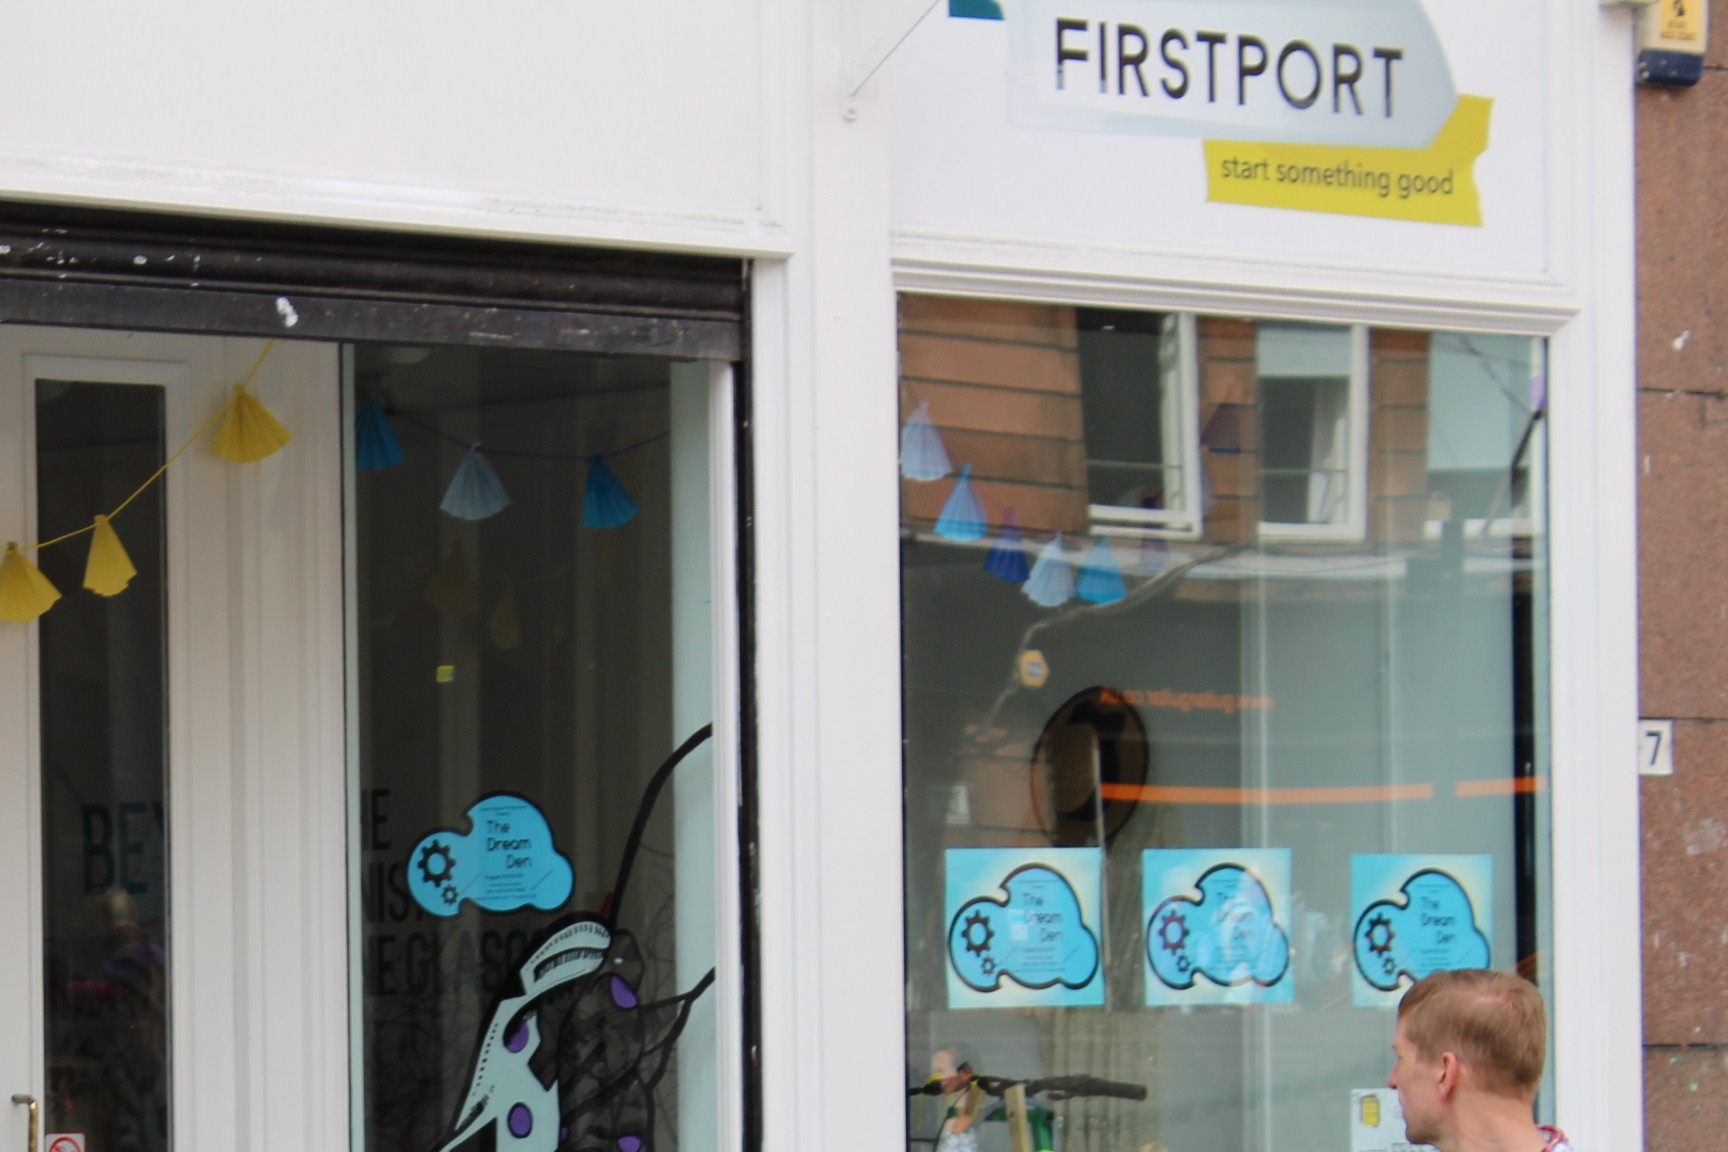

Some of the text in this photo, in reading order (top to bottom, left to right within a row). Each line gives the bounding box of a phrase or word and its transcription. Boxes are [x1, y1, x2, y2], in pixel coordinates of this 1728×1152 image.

[1055, 16, 1403, 118] FIRSTPORT
[1221, 155, 1454, 200] start something good
[1645, 730, 1663, 767] 7
[486, 820, 511, 834] The
[486, 837, 531, 853] Dream
[506, 853, 533, 870] Den
